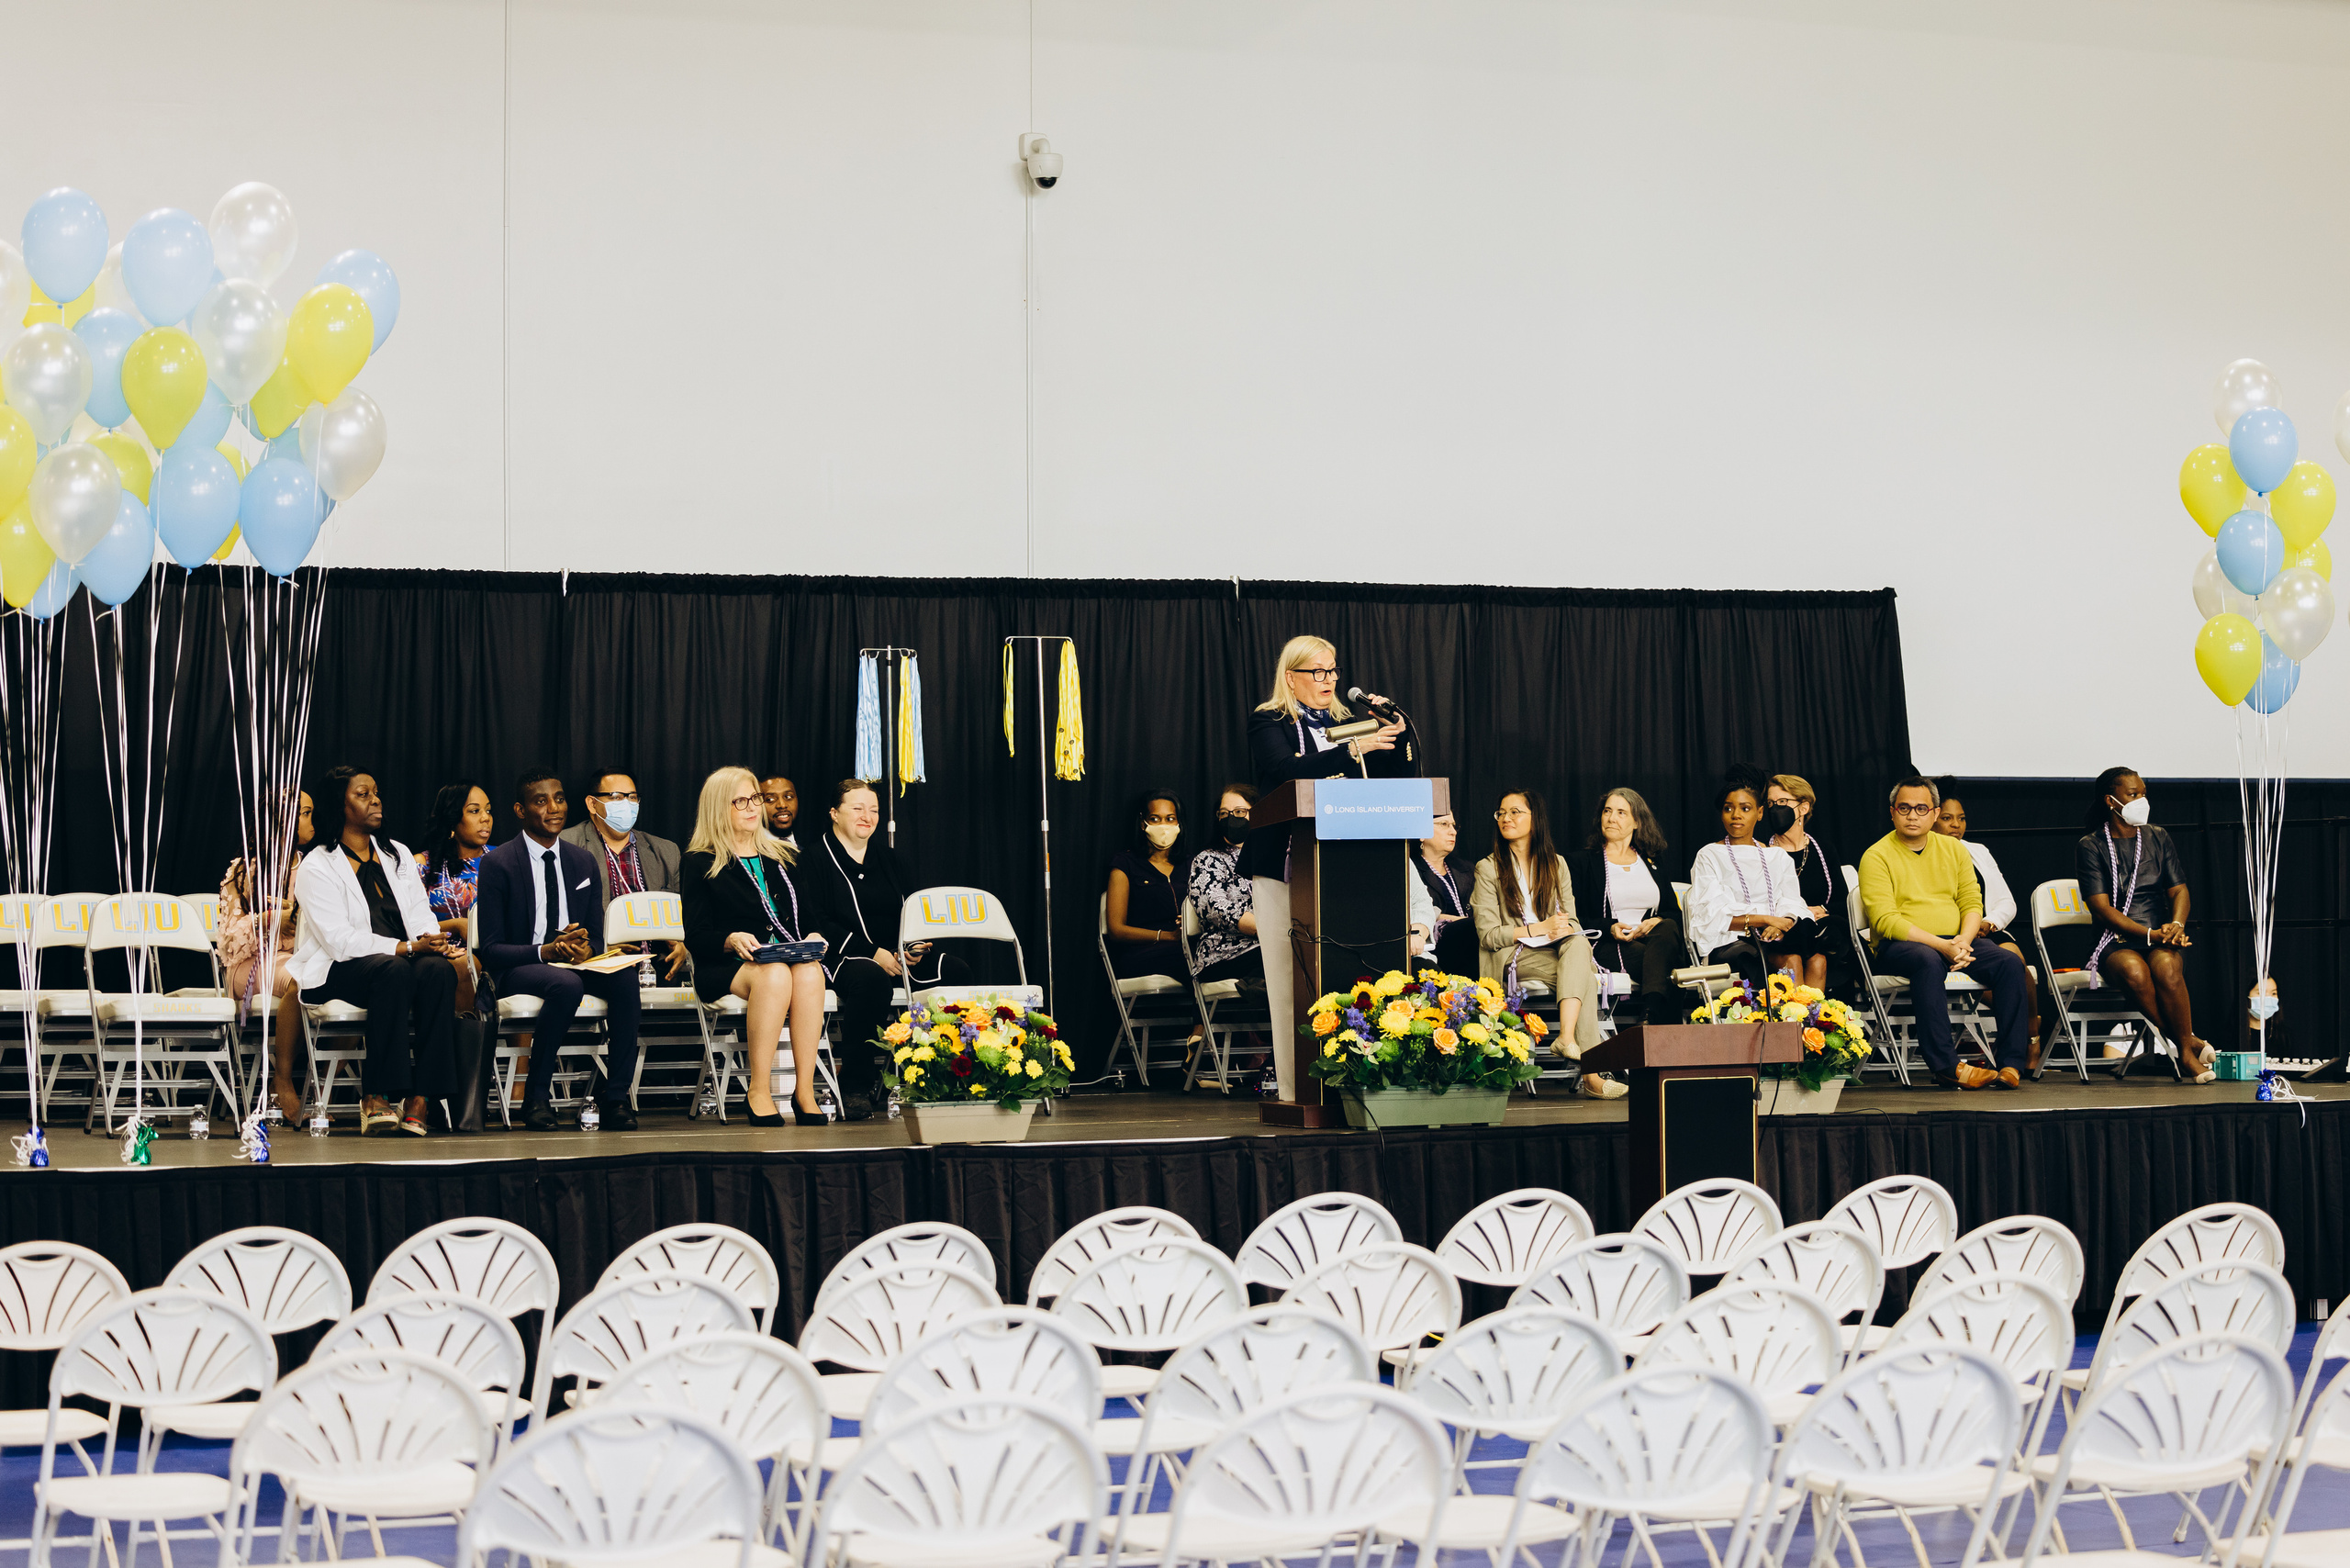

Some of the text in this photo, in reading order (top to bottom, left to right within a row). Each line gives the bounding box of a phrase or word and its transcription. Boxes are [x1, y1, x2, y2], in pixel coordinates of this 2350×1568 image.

[1335, 805, 1355, 813] LONG
[1357, 805, 1382, 813] ISLAND
[919, 893, 989, 925] LIU
[2047, 886, 2090, 914] LI
[50, 902, 97, 934] LI
[109, 901, 183, 934] LIU
[153, 1002, 202, 1014] SHARKS
